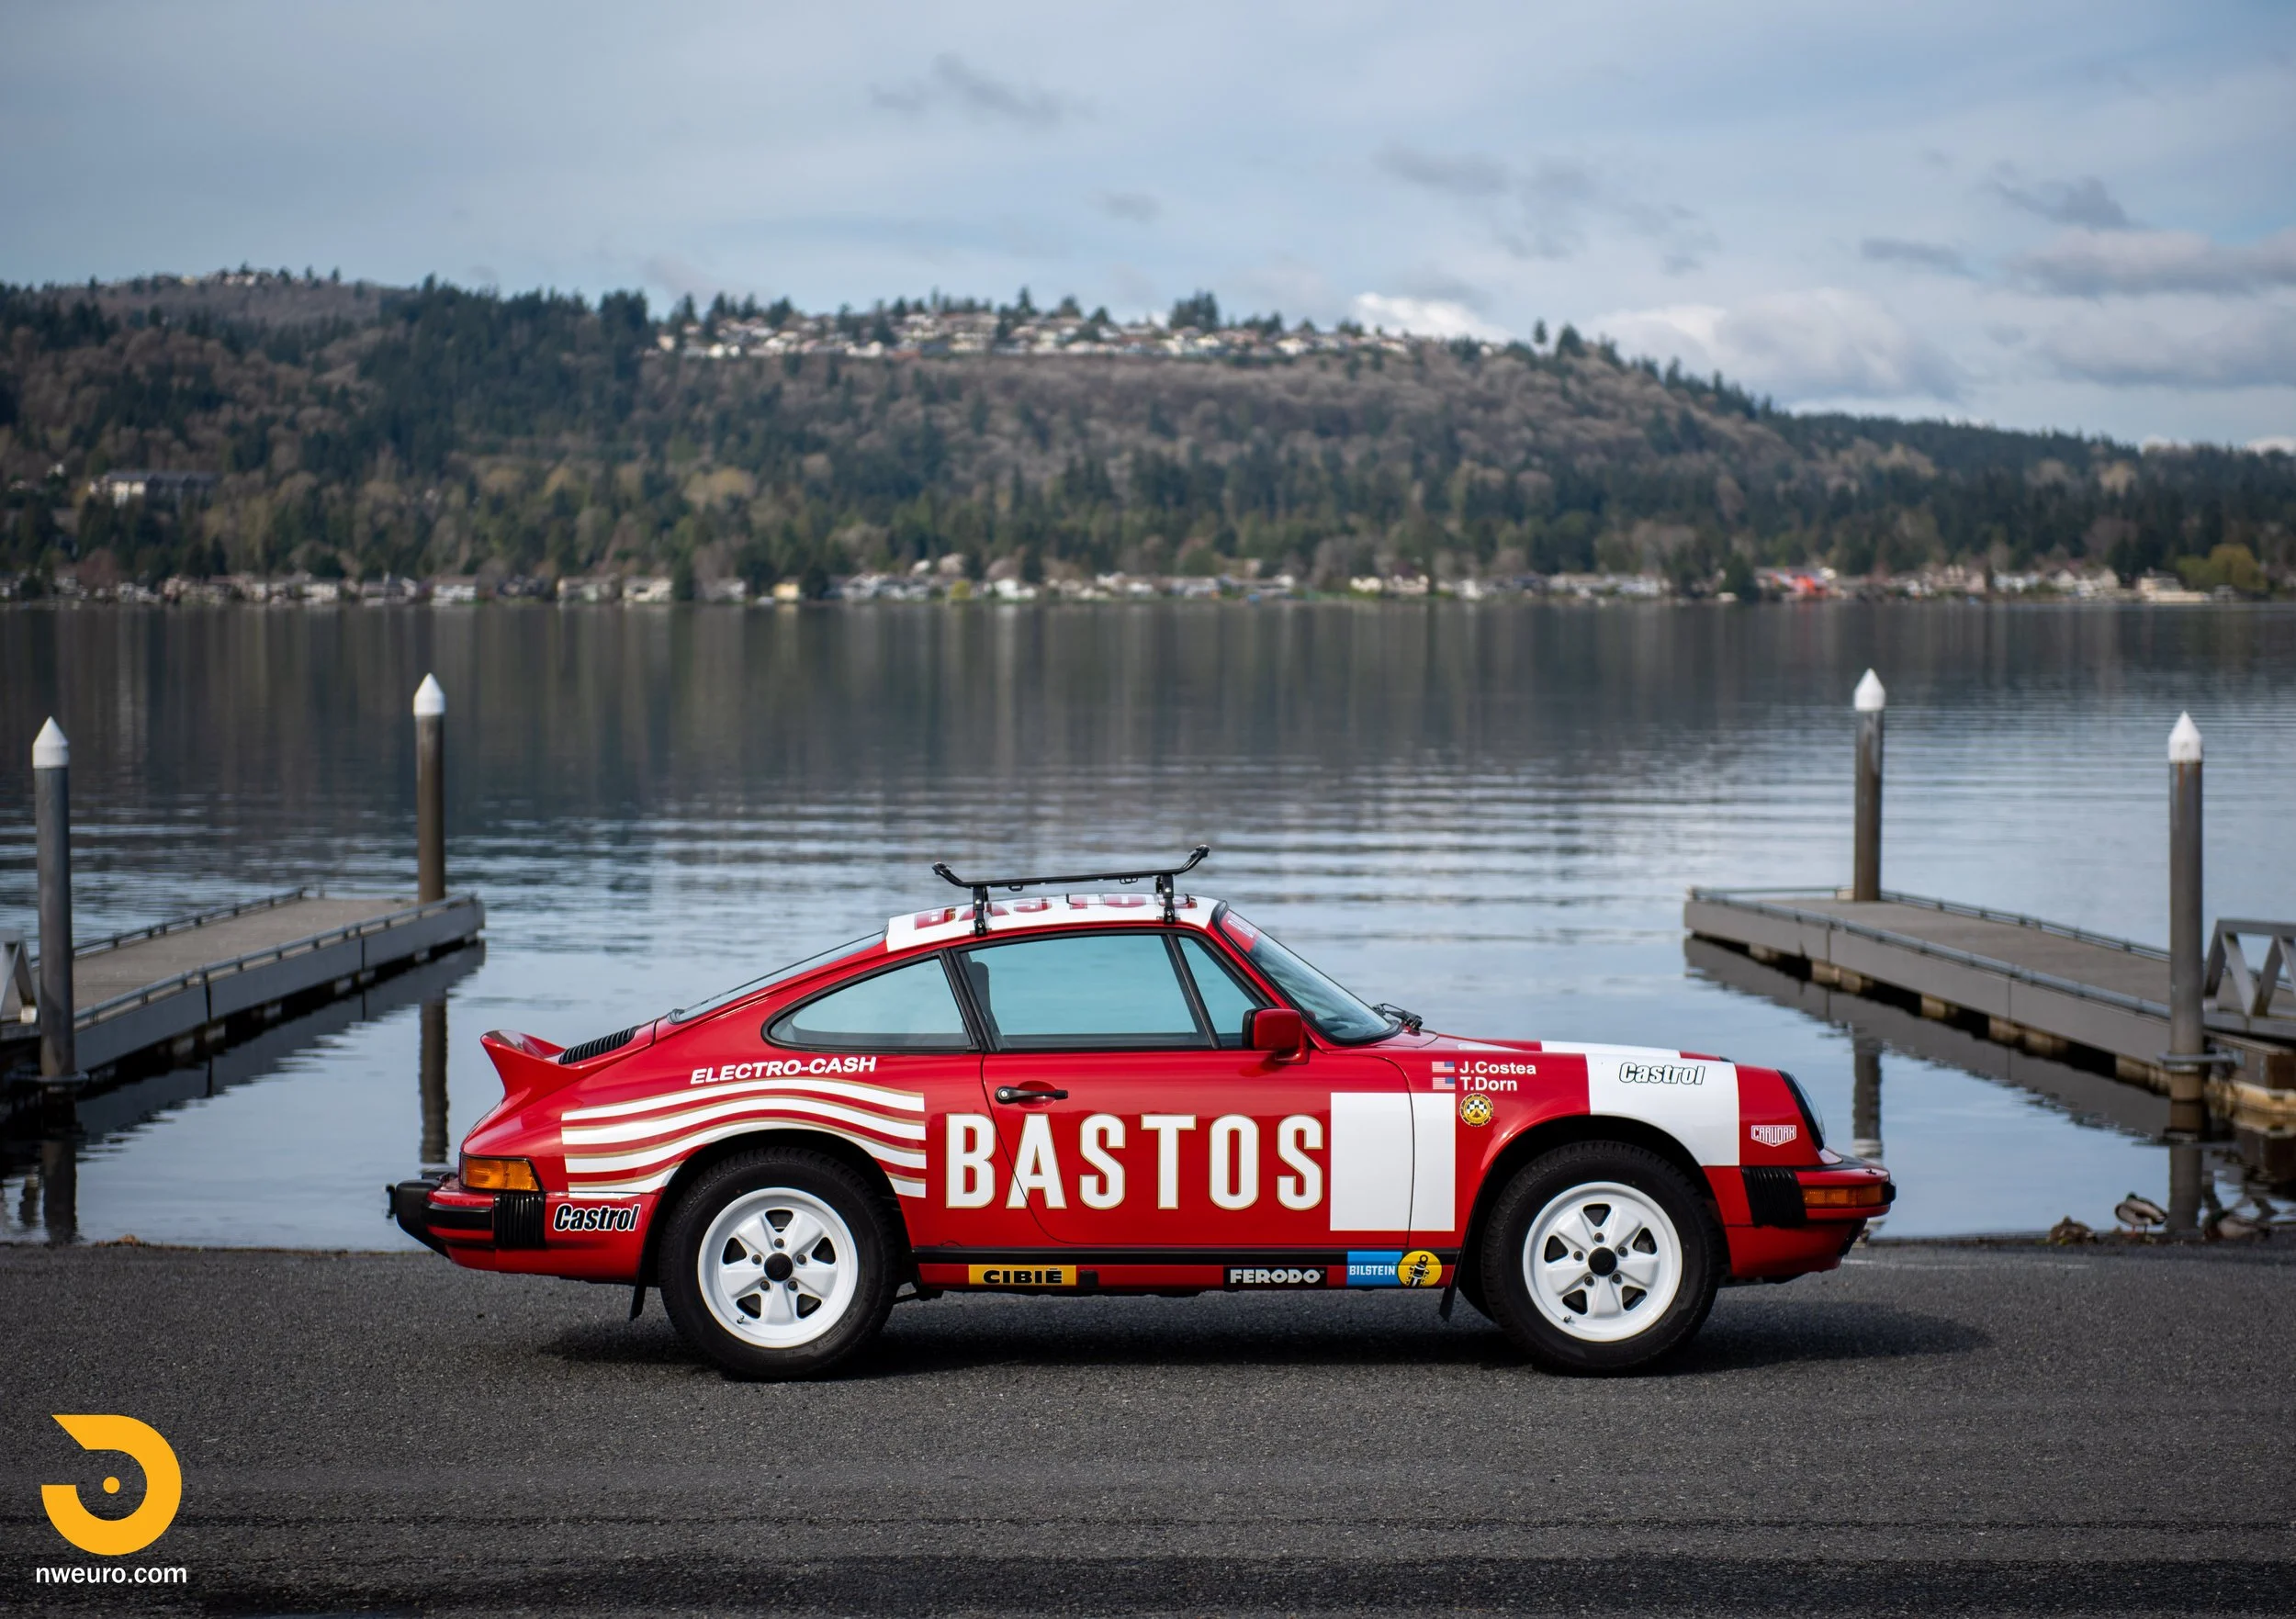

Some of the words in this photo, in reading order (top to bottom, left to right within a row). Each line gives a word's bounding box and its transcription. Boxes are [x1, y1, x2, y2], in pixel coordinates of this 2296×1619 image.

[690, 1056, 877, 1085] ELECTRO-CASH
[1458, 1061, 1537, 1075] J.Costea
[1618, 1062, 1706, 1085] Castrol
[1459, 1076, 1518, 1092] T.Dorn
[945, 1113, 1324, 1211] BASTOS
[553, 1203, 641, 1231] Castrol
[1230, 1269, 1321, 1284] FERODO
[1349, 1265, 1396, 1276] BILSTEIN
